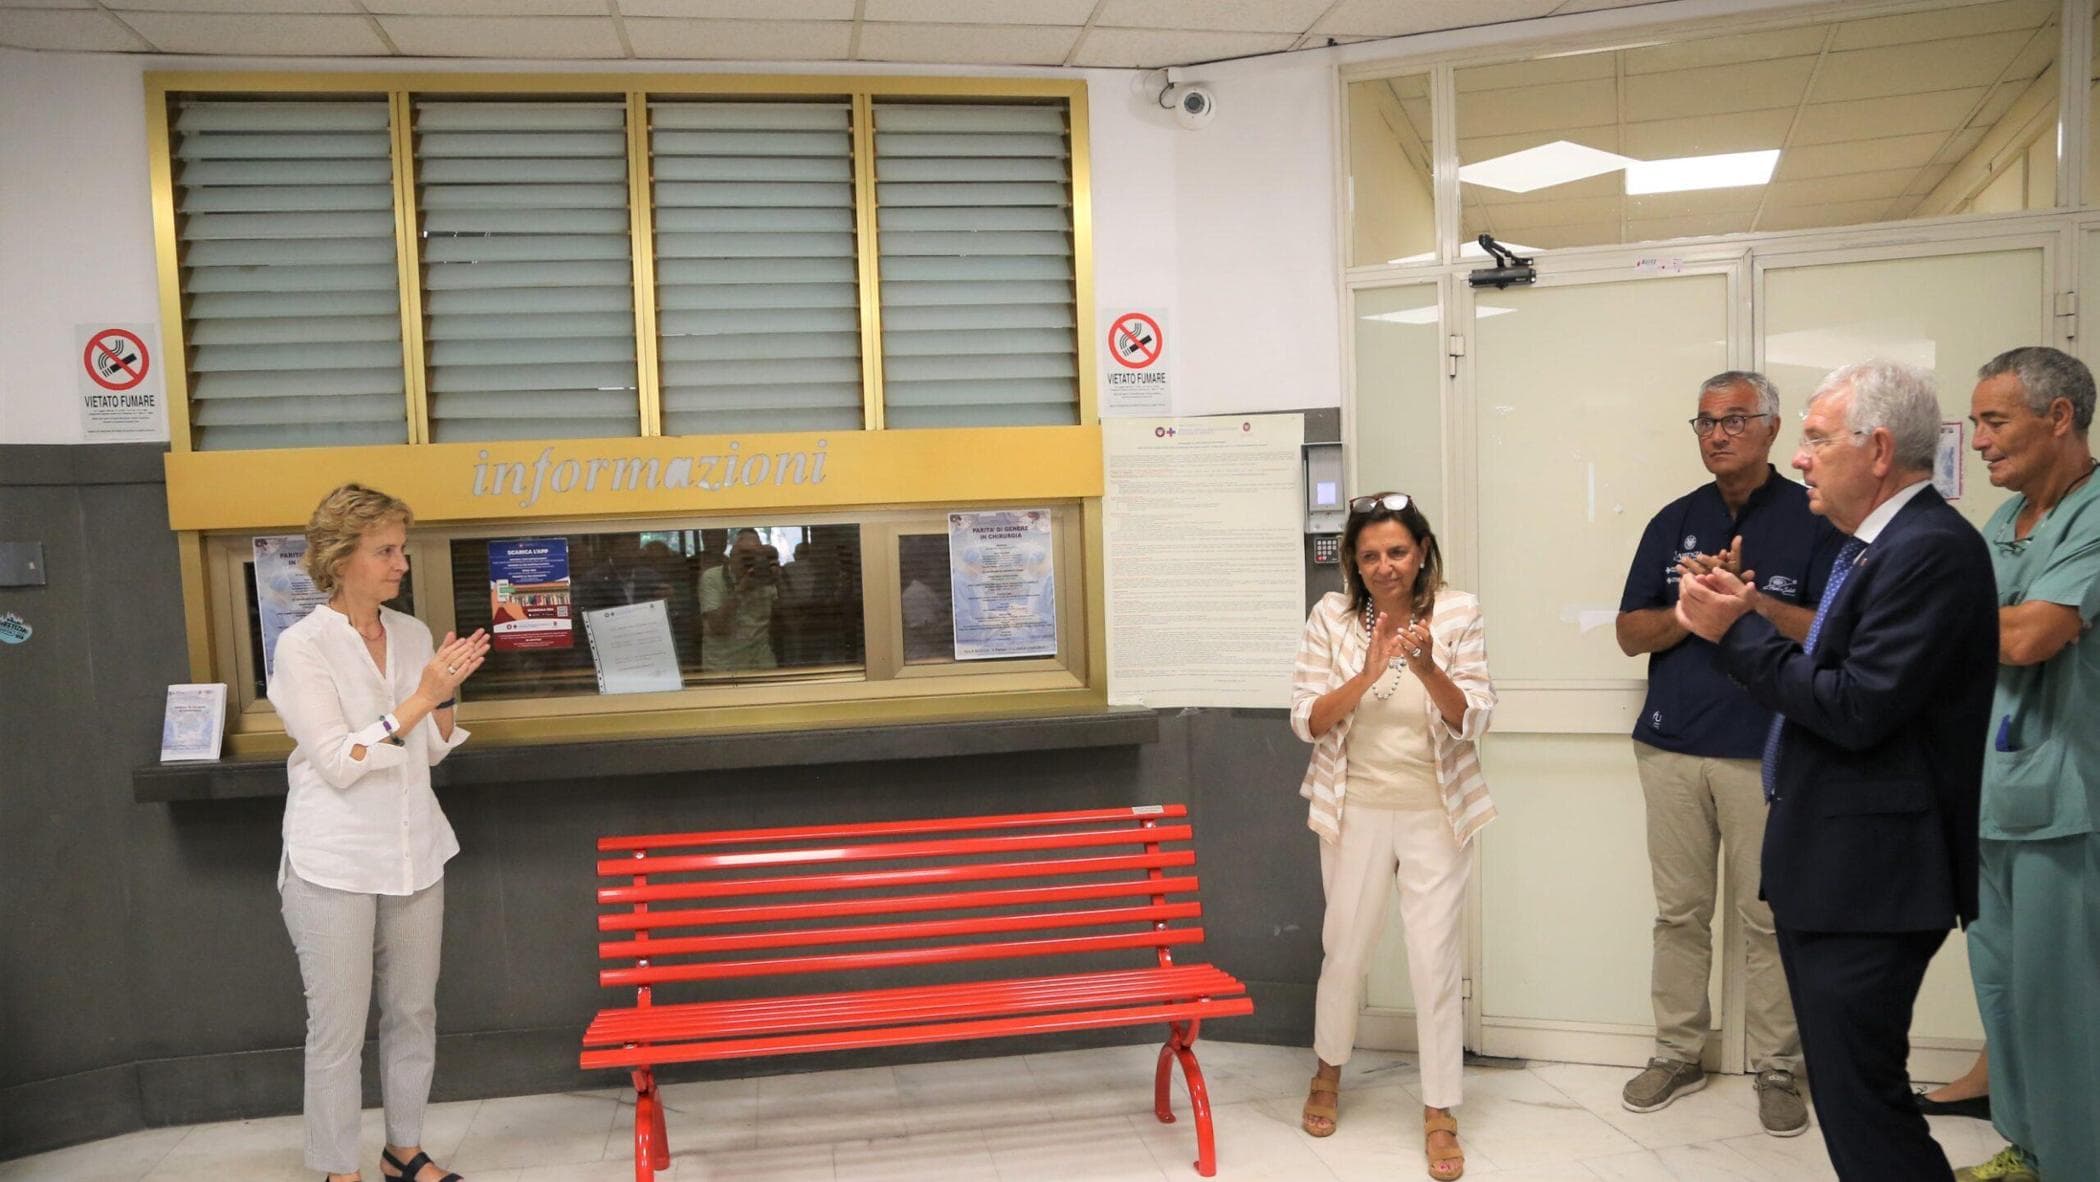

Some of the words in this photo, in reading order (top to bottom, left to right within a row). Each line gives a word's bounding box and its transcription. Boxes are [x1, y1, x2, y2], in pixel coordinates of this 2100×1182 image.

[1107, 373, 1136, 384] VIETATO
[1137, 372, 1166, 384] FUMARE
[85, 395, 118, 407] VIETATO
[120, 395, 155, 407] FUMARE
[471, 439, 829, 509] informazioni
